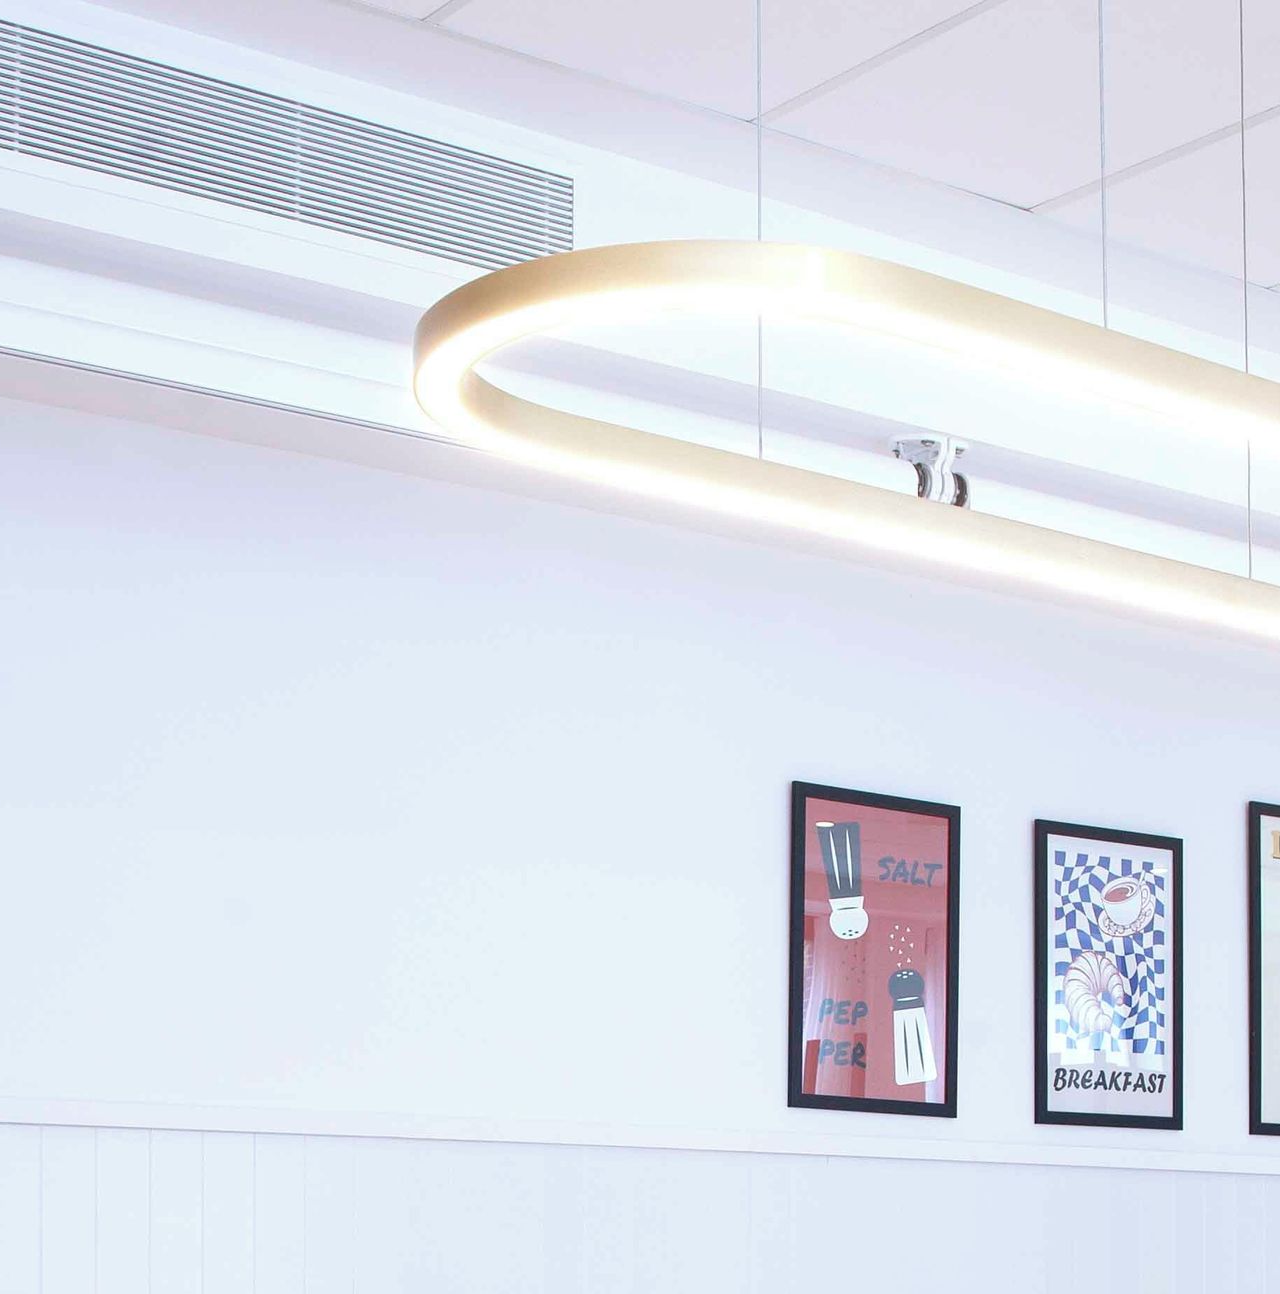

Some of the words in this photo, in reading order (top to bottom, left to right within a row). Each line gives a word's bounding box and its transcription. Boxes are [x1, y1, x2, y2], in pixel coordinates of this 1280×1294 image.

[877, 855, 943, 888] SALT
[818, 998, 869, 1026] PEP
[819, 1039, 867, 1069] PER
[1053, 1068, 1167, 1094] BREAKFAST
